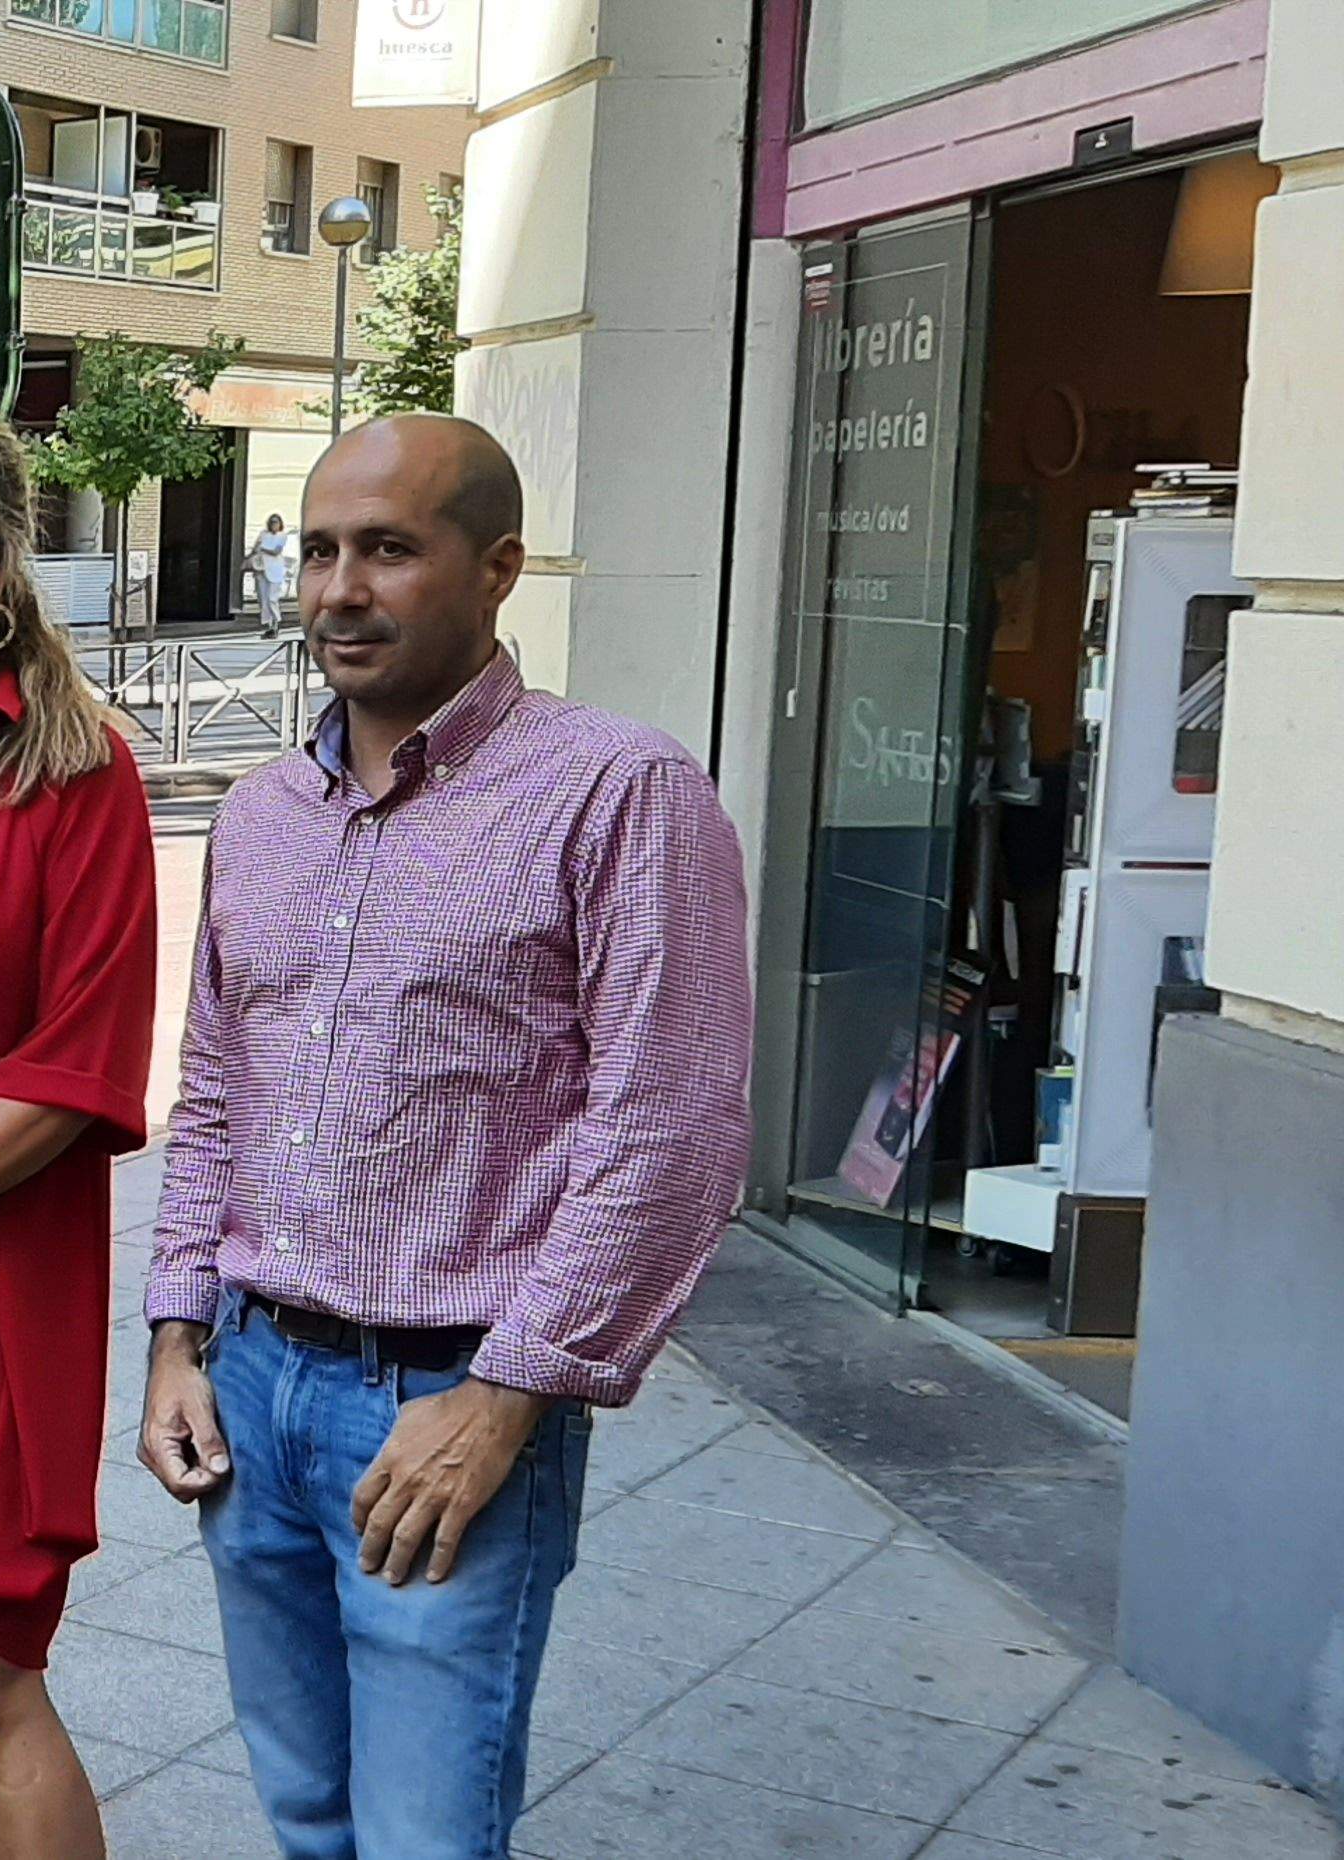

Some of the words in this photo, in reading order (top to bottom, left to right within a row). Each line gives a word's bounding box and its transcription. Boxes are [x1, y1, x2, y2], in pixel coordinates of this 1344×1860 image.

[378, 39, 453, 55] huesca
[814, 298, 933, 371] librería
[812, 399, 927, 463] papelería
